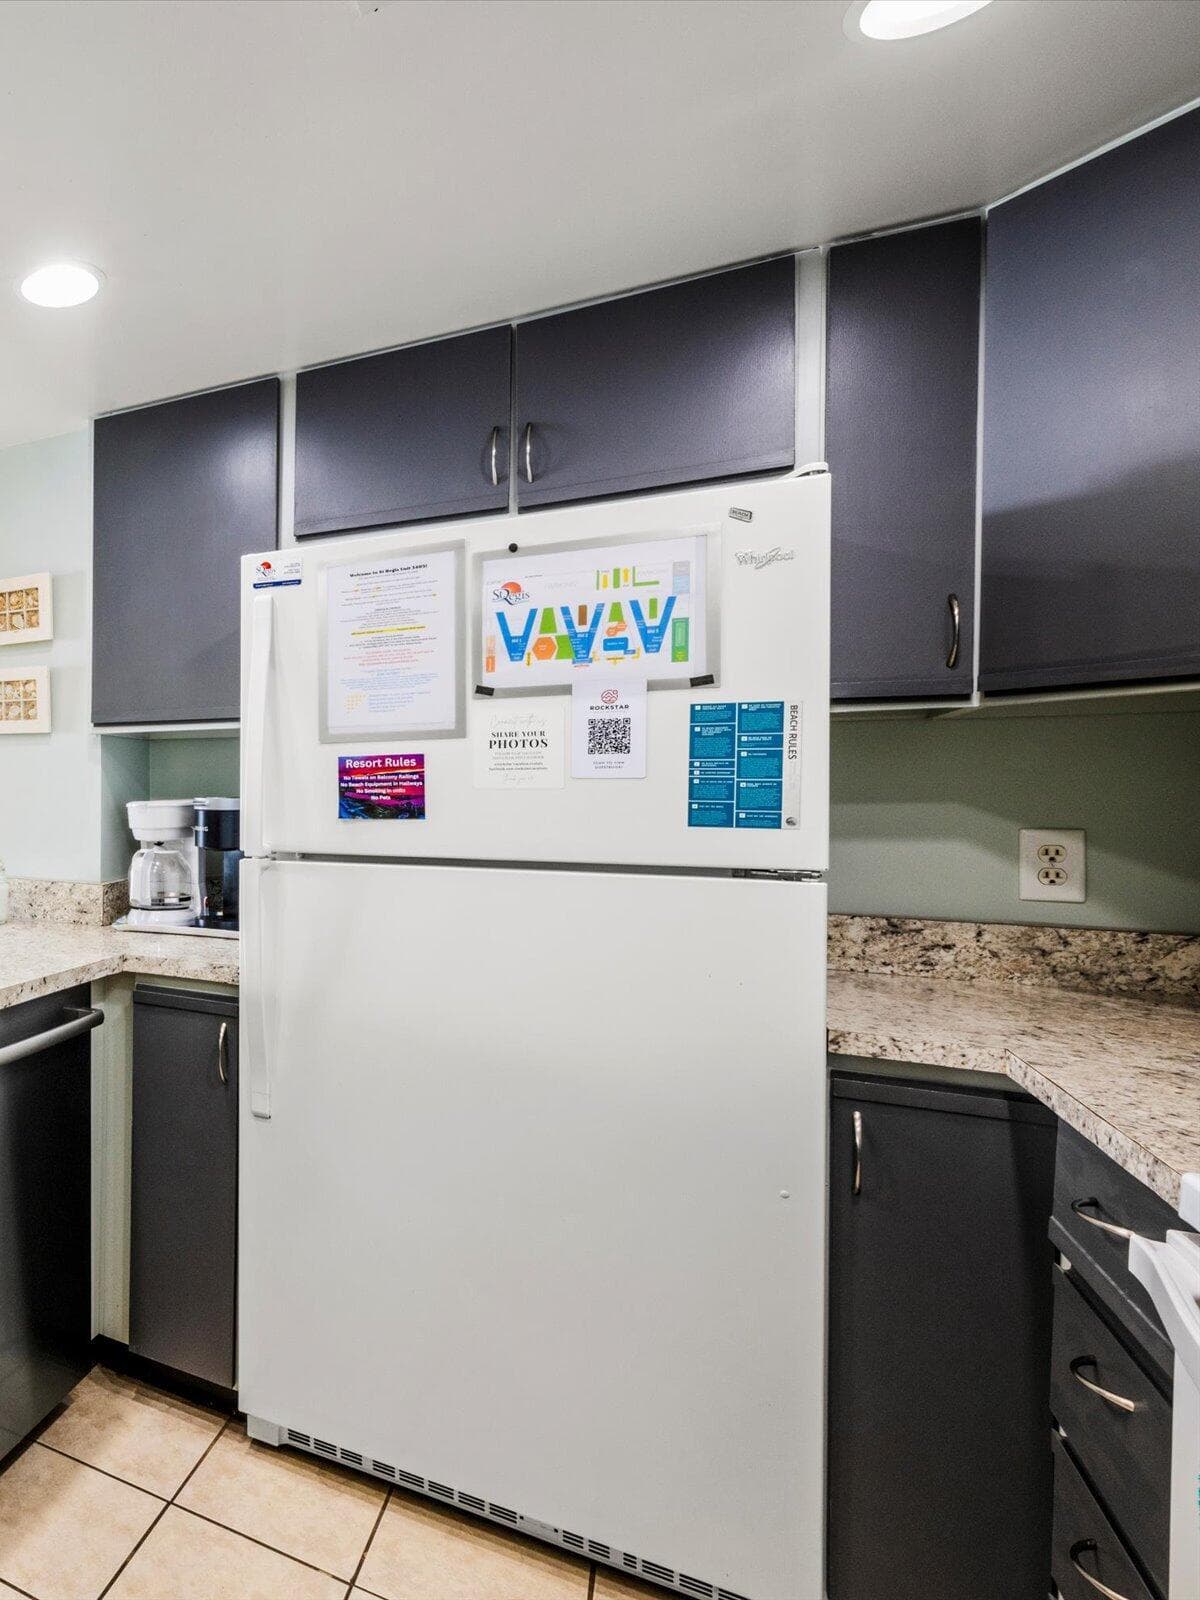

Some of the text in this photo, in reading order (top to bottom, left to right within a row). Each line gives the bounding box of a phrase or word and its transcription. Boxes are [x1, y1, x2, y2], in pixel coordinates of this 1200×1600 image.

[788, 705, 798, 760] BEACH RULES
[489, 739, 548, 749] PHOTOS
[345, 757, 416, 768] Resort Rules
